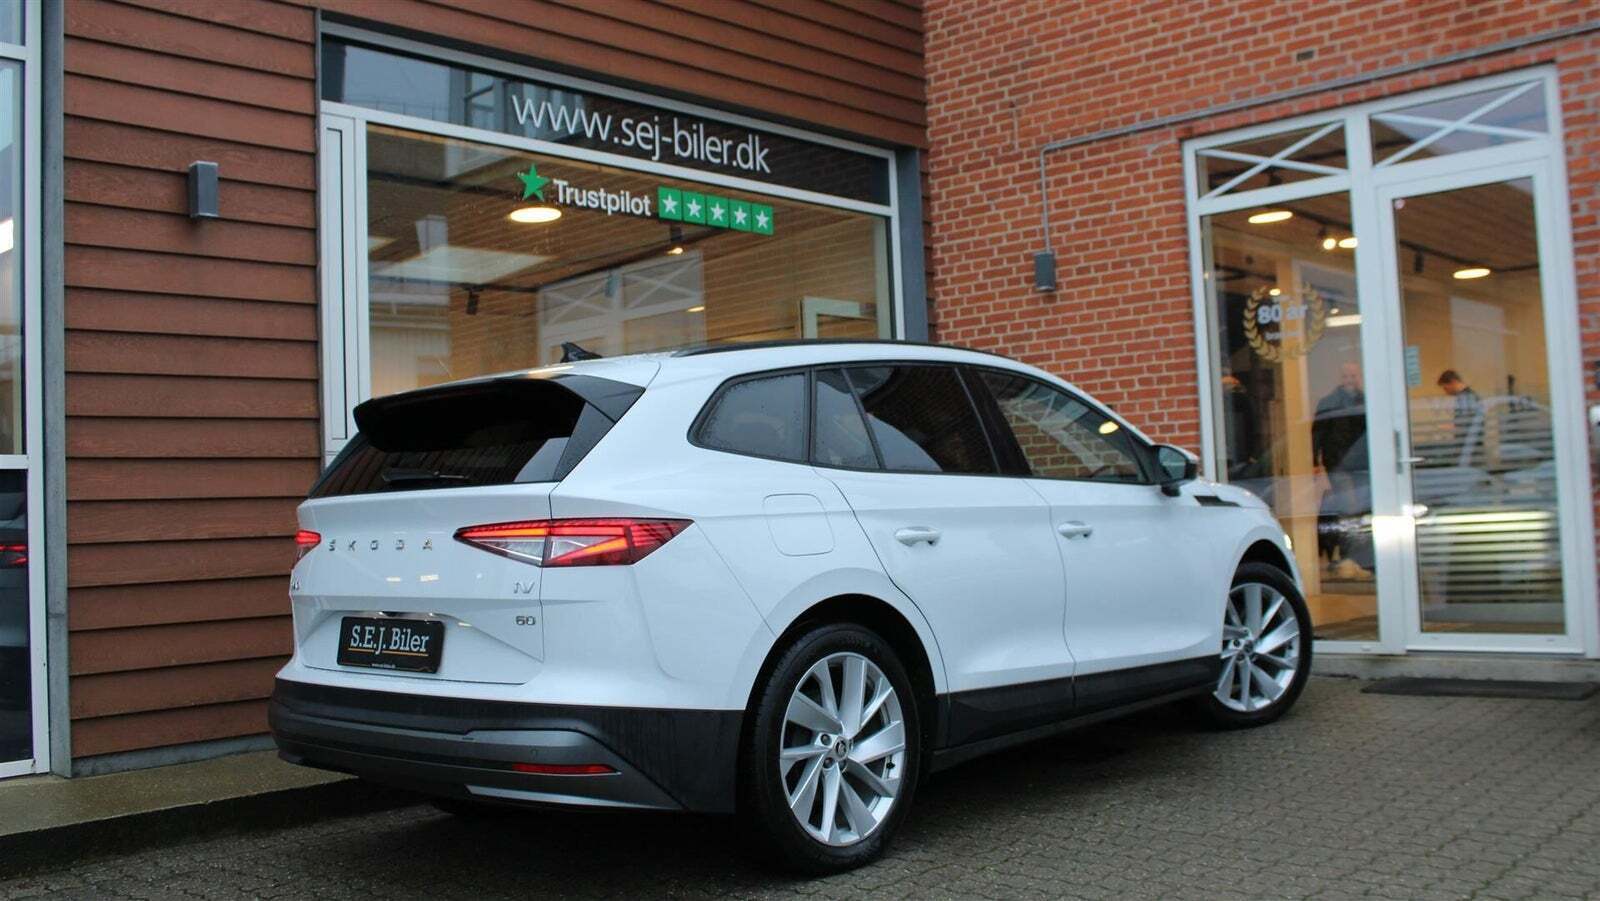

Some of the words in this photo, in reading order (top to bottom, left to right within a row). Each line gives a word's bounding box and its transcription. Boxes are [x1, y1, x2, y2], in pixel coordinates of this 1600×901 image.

[512, 95, 771, 174] www.sej-biler.dk
[553, 178, 652, 216] Trustpilot
[1257, 304, 1282, 324] 80
[515, 615, 536, 626] 60
[350, 624, 386, 655] S.E.J.
[389, 626, 430, 653] Biler
